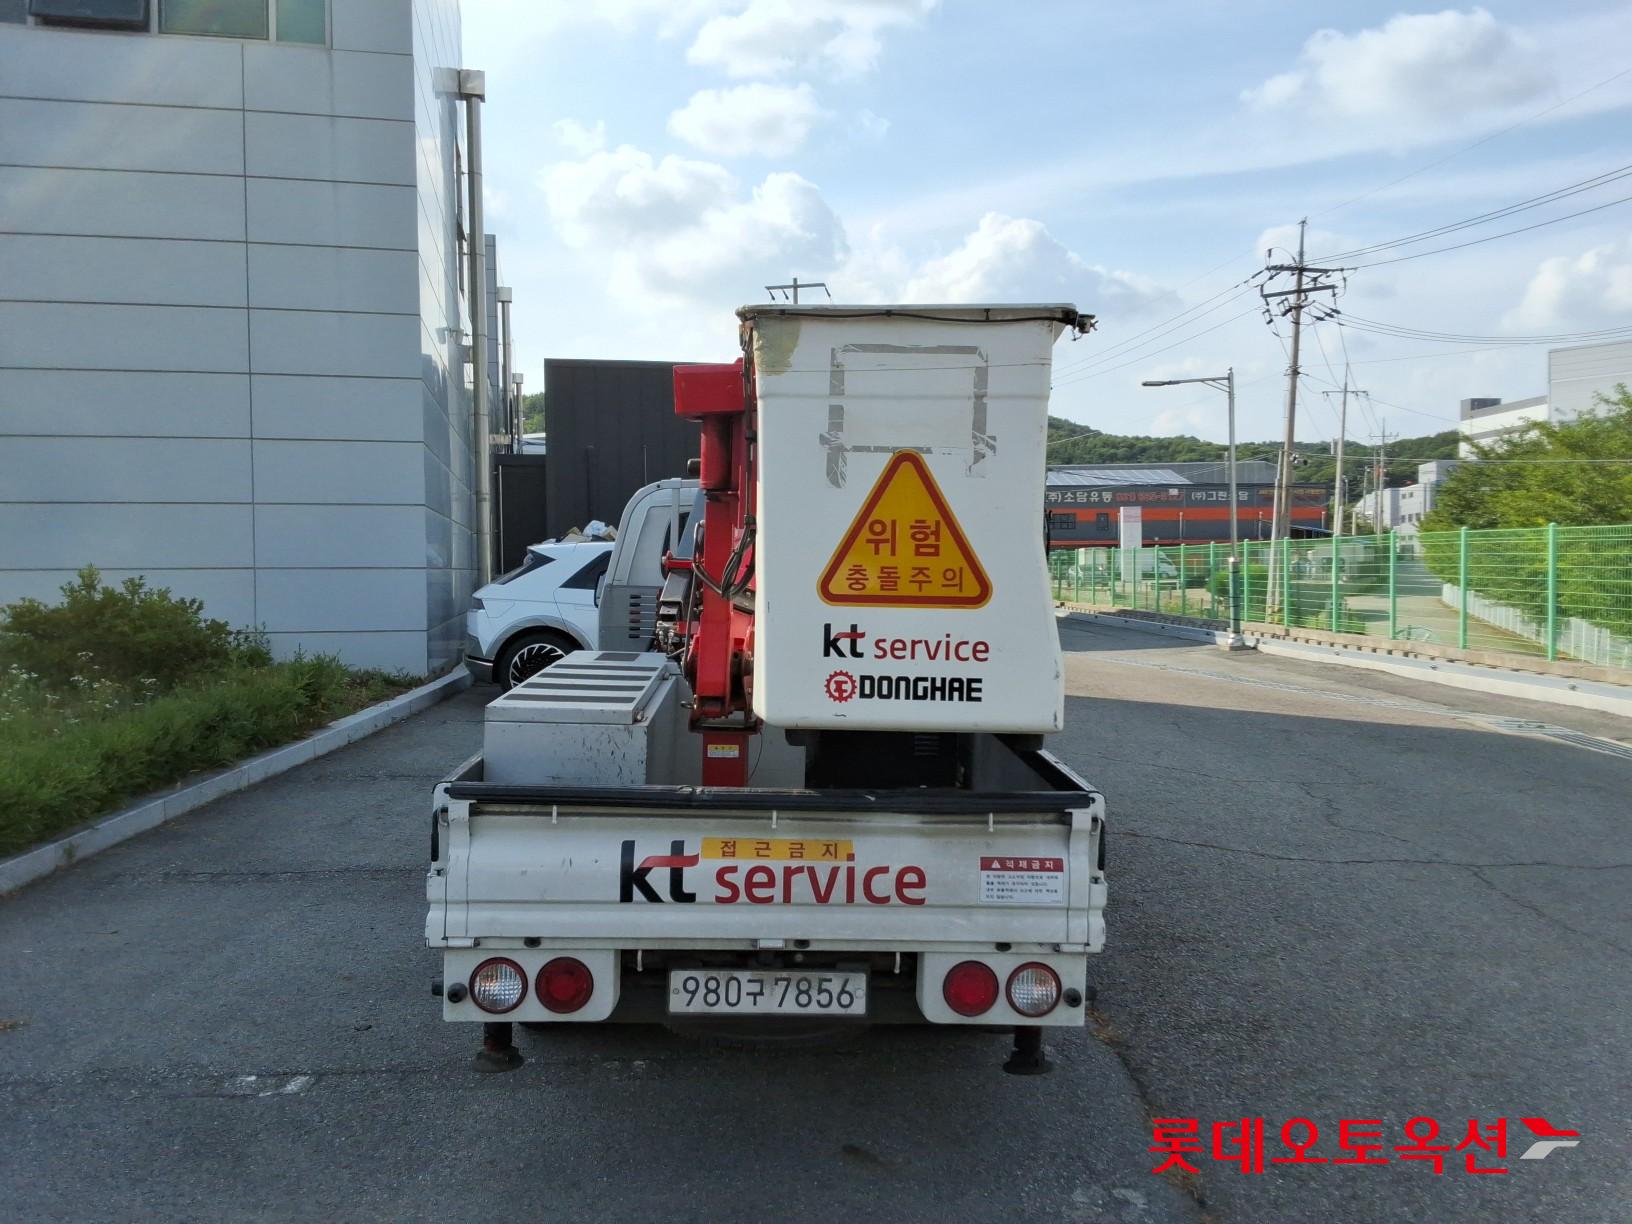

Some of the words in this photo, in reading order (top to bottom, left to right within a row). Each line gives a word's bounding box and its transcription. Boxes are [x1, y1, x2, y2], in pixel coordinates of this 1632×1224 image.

[865, 518, 941, 557] 위험
[845, 564, 964, 593] 충돌주의
[822, 622, 866, 659] kt
[873, 633, 990, 662] service
[858, 674, 983, 702] DONGHAE
[719, 840, 839, 859] 접근금지
[619, 839, 700, 904] kt
[714, 852, 927, 906] service
